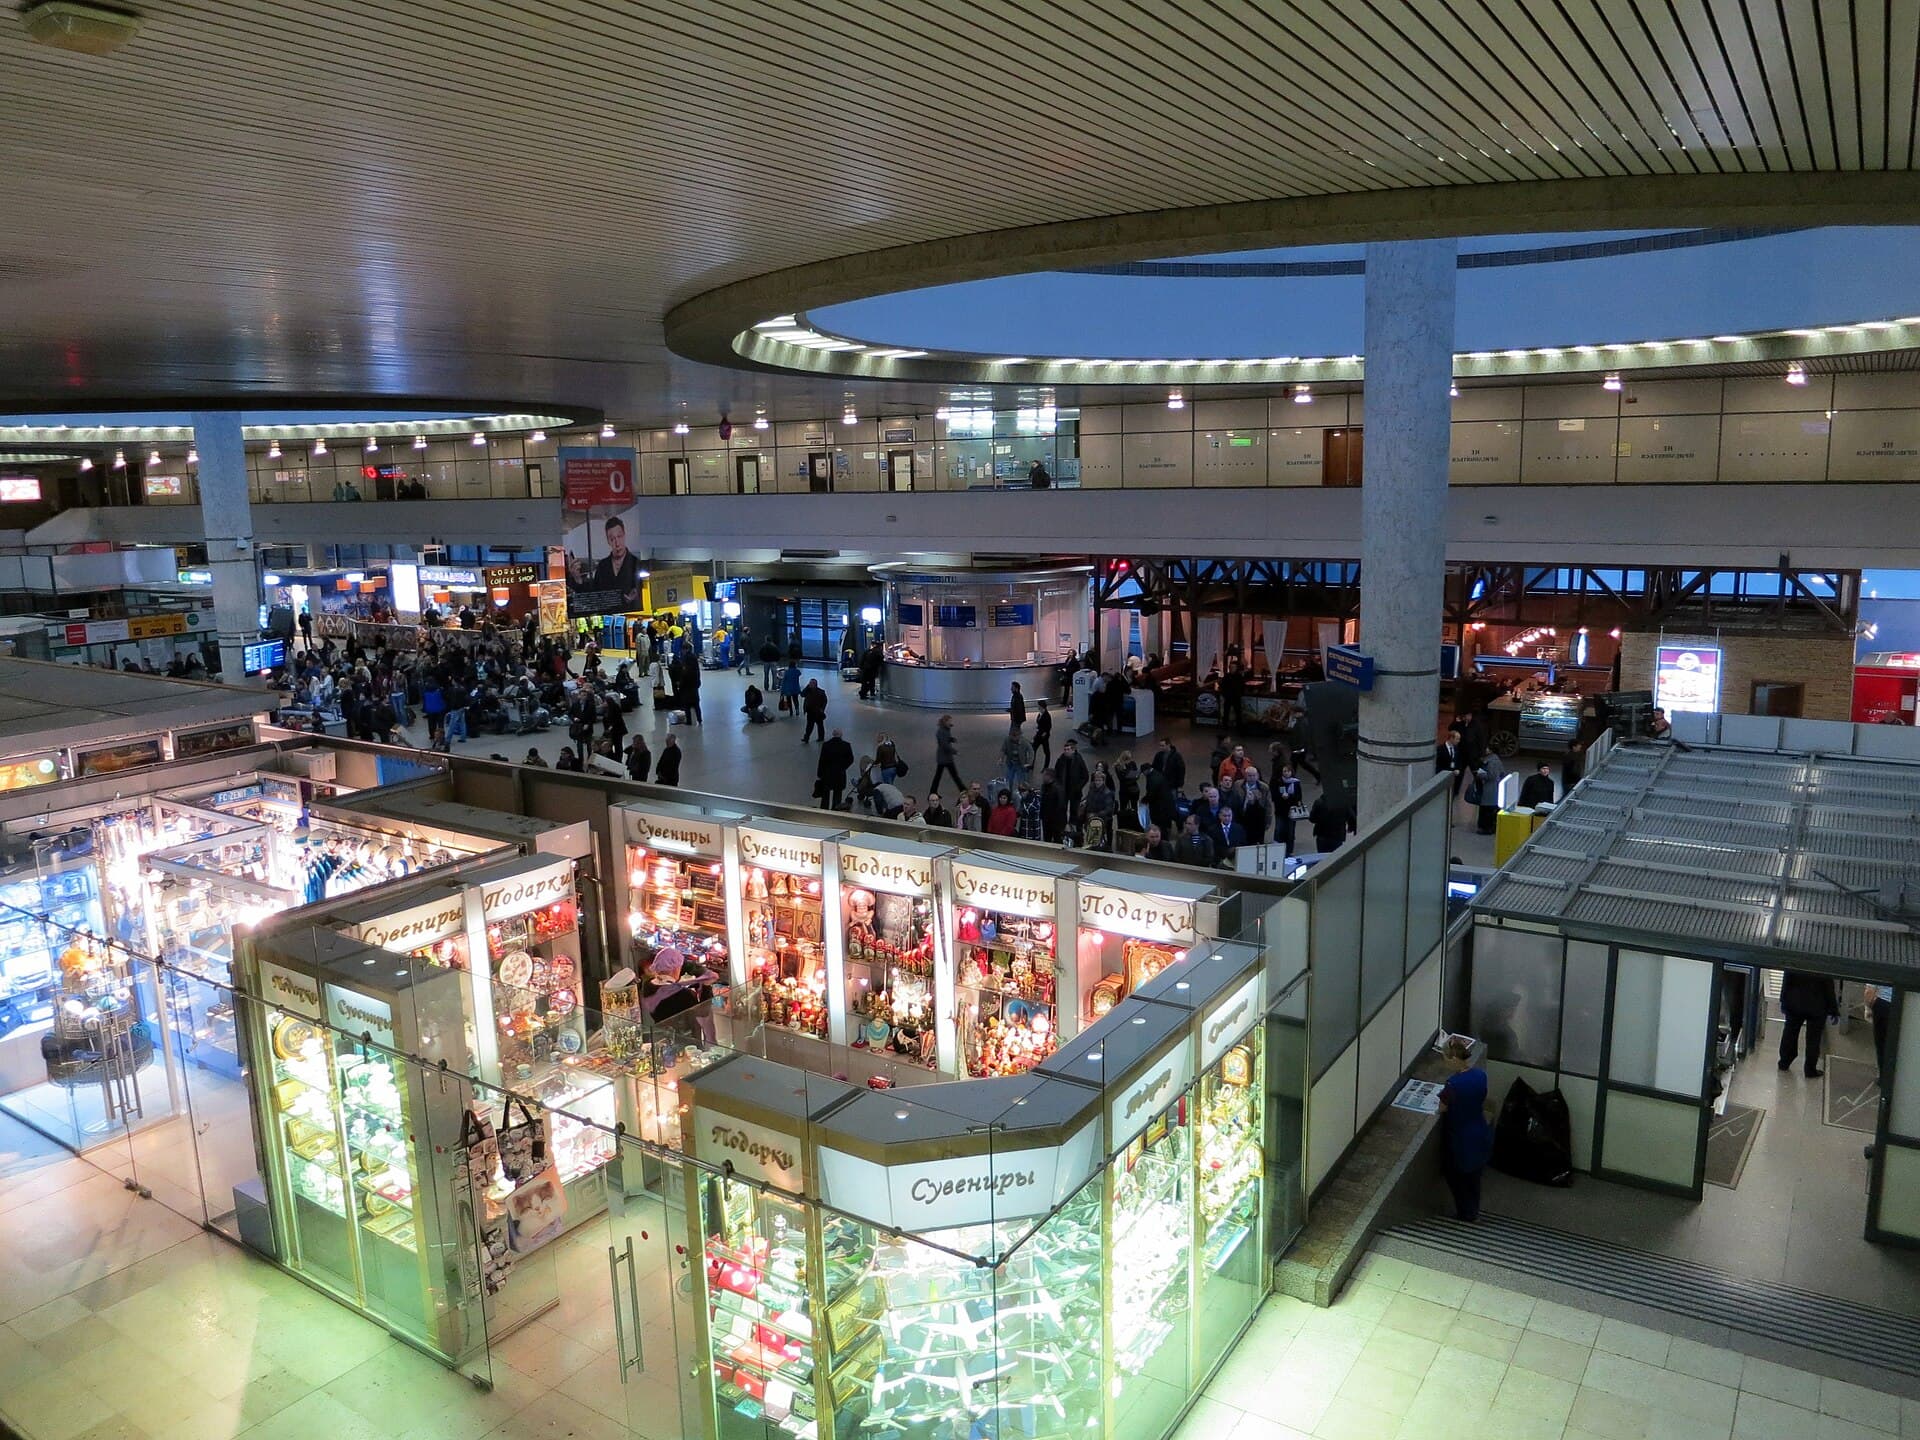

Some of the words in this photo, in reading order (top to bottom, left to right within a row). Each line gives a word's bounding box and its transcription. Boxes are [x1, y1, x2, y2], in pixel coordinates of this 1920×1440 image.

[609, 470, 625, 493] 0
[490, 576, 515, 586] COFFEE
[518, 574, 535, 583] SHOP
[219, 792, 228, 803] FC
[229, 787, 247, 801] ZENIT
[637, 817, 711, 849] Сувениры
[742, 834, 822, 868] Сувениры
[842, 853, 930, 887] Подарки
[485, 871, 571, 912] Подарки
[954, 870, 1055, 908] Сувениры
[363, 905, 464, 947] Сувениры
[1082, 894, 1195, 934] Подарки
[337, 998, 393, 1032] Сувениры
[711, 1125, 795, 1171] Подарки
[911, 1169, 1035, 1205] Сувениры
